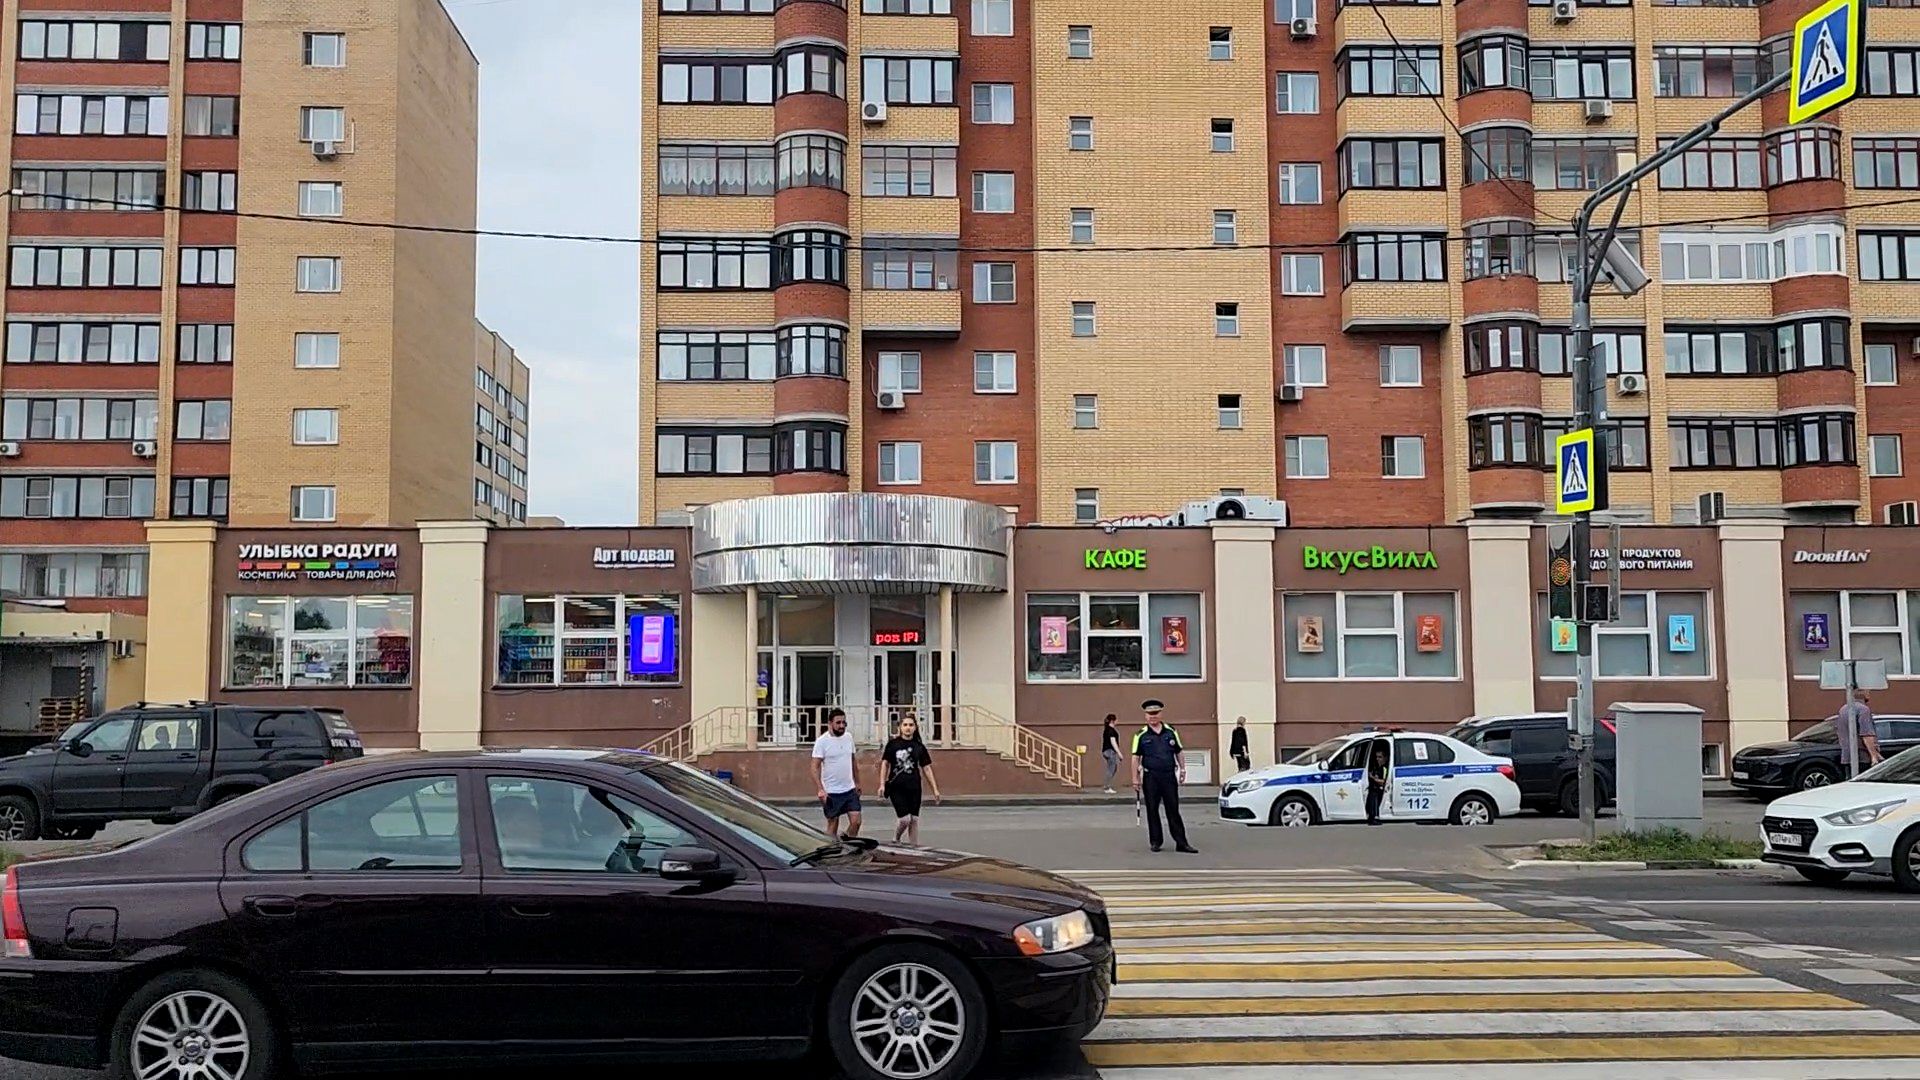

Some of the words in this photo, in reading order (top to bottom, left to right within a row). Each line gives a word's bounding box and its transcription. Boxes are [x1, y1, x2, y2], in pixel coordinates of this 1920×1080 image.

[593, 547, 618, 562] Арт
[620, 549, 675, 562] подвал
[1085, 548, 1147, 568] КАФЕ
[1304, 545, 1439, 574] ВкусВилл
[1622, 549, 1682, 558] ПРОДУКТОВ
[1647, 560, 1694, 569] ПИТАНИЯ
[238, 571, 297, 579] КОСМЕТИКА
[306, 570, 345, 579] ТОВАРЫ
[345, 571, 366, 580] ДЛЯ
[366, 570, 396, 580] ДОМА
[1407, 797, 1430, 810] 112
